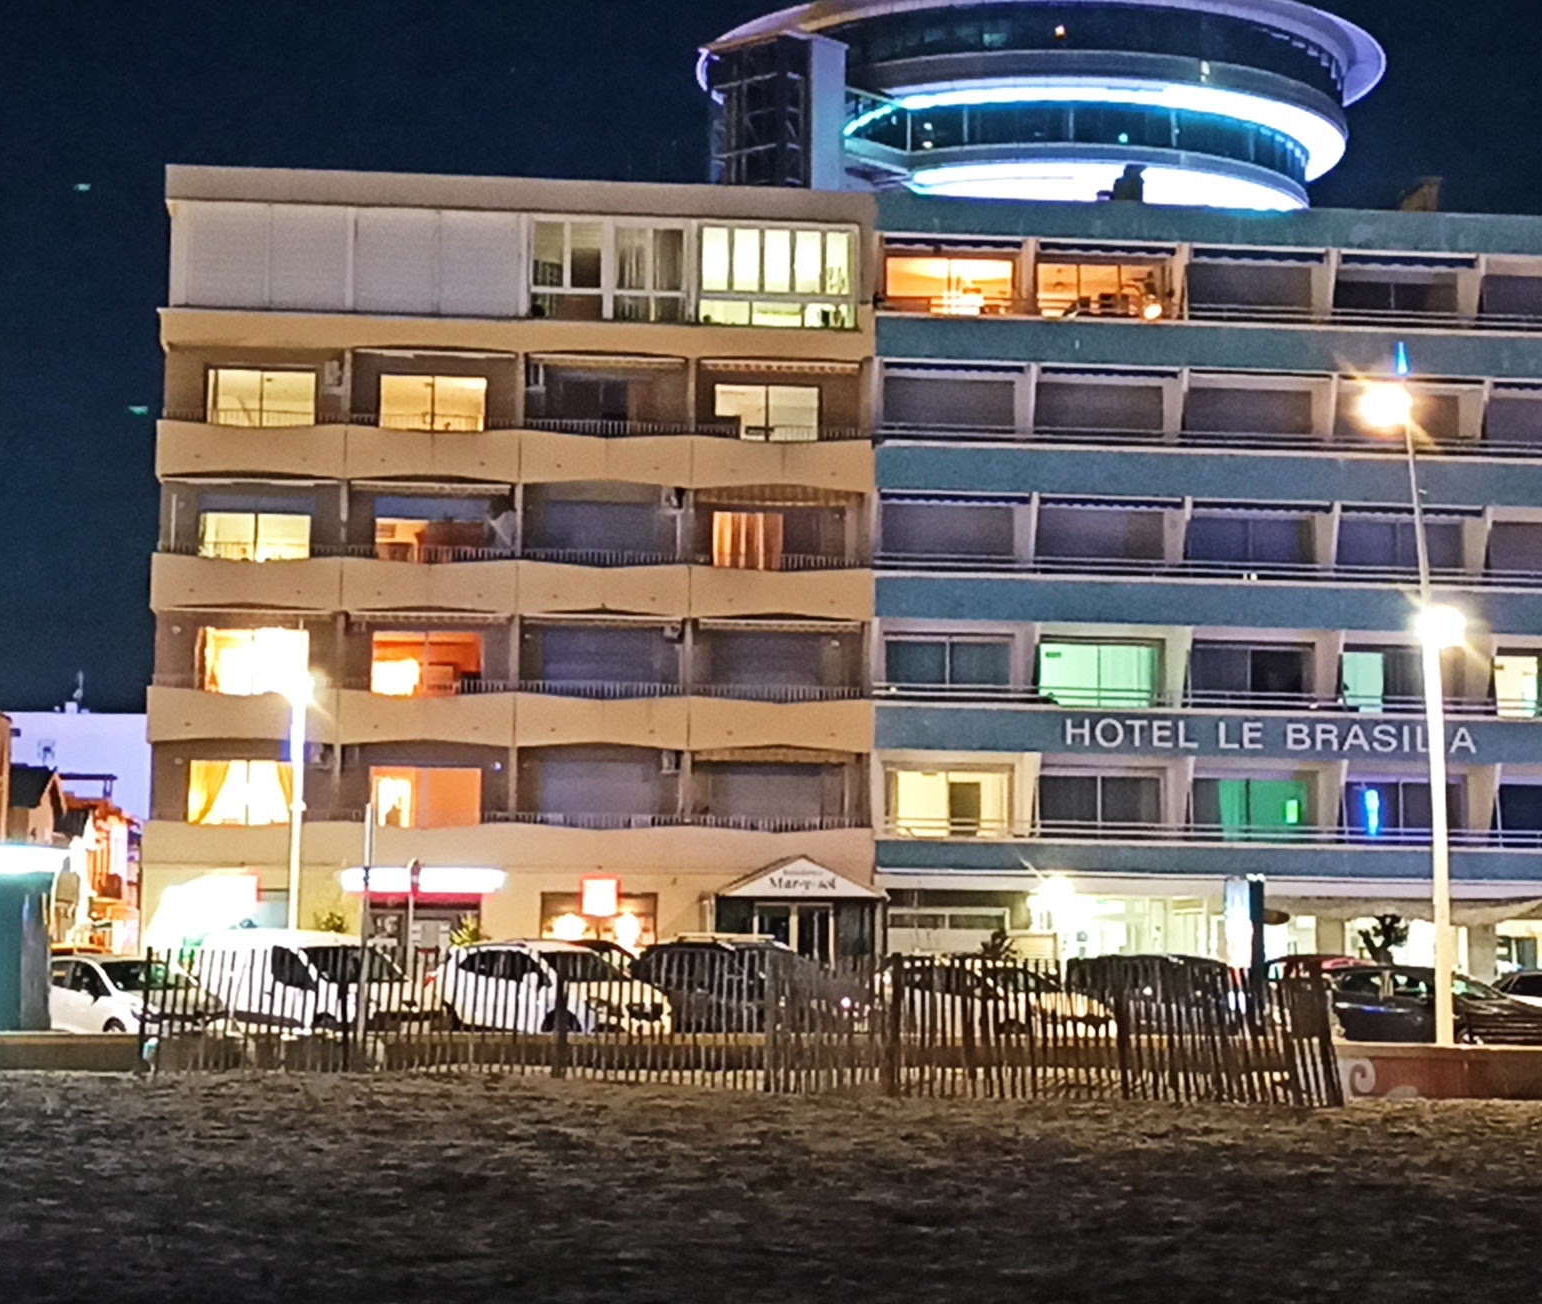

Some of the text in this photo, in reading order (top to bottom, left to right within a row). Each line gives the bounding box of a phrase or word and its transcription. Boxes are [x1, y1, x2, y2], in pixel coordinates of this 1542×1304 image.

[1065, 718, 1478, 754] HOTEL LE BRASILA
